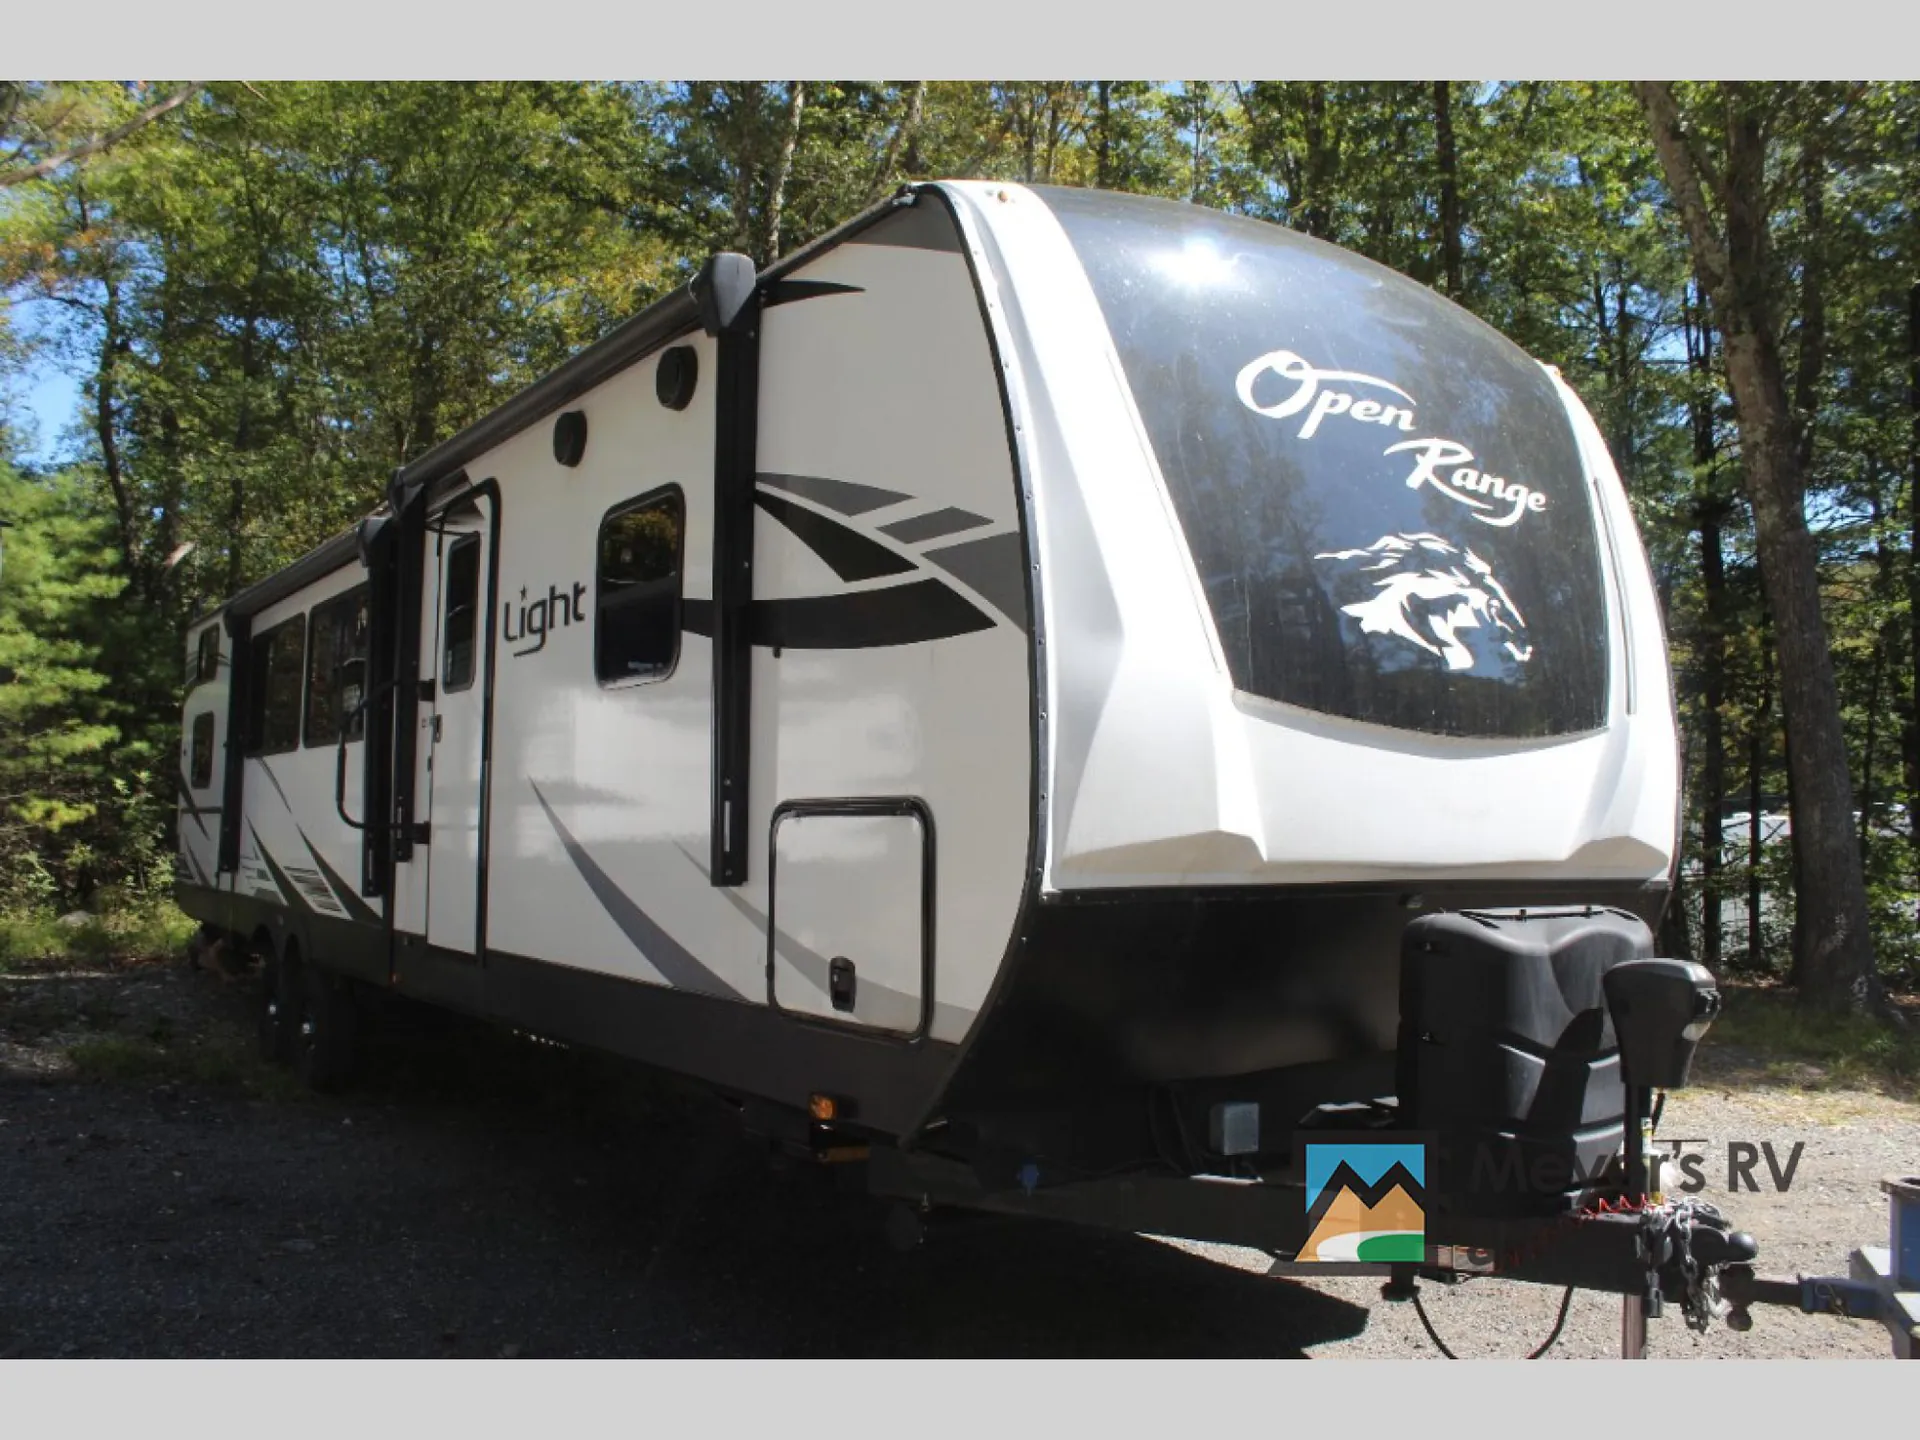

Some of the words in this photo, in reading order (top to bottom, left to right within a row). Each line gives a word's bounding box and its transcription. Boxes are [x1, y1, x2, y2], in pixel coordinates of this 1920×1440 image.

[1235, 350, 1416, 439] Open
[1383, 437, 1546, 527] Range
[503, 581, 587, 657] Light
